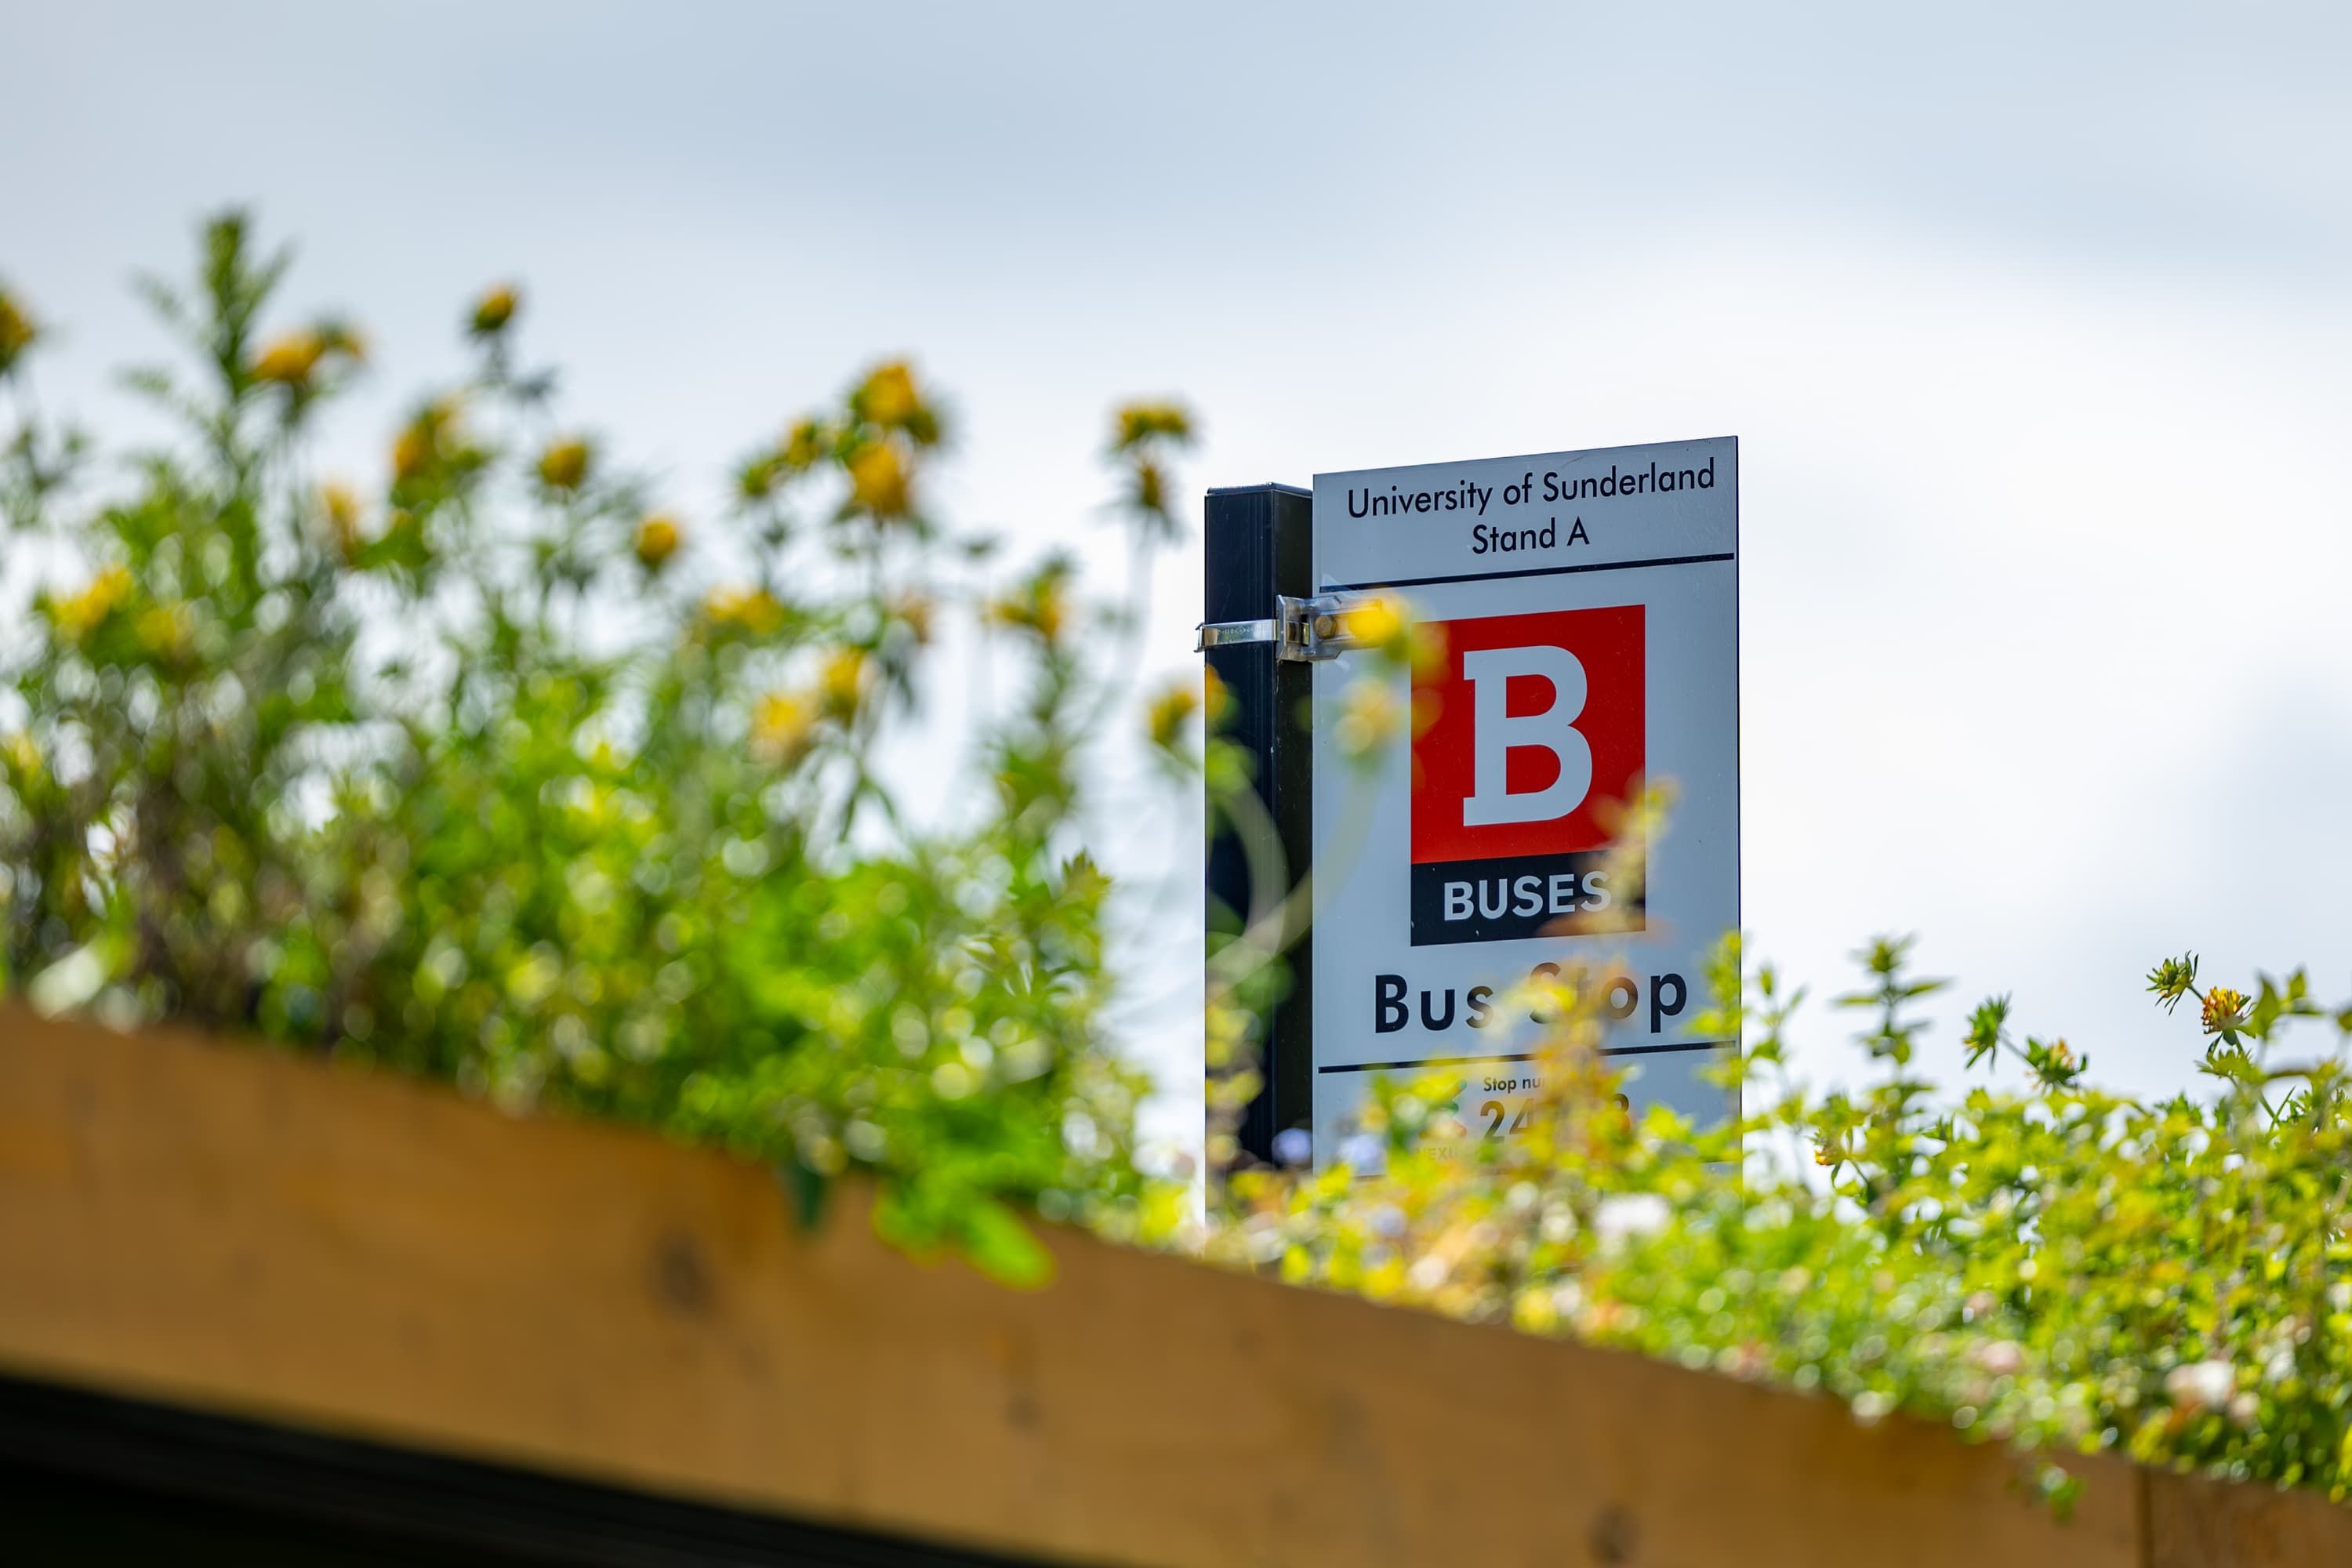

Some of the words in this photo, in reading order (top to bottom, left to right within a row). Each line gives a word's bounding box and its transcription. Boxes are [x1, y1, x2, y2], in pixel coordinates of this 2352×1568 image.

[1347, 479, 1494, 518] University
[1503, 472, 1534, 505] of
[1542, 456, 1715, 502] Sunderland
[1472, 517, 1556, 554] Stand
[1566, 516, 1591, 546] A
[1463, 644, 1593, 827] B
[1443, 870, 1612, 921] BUSES
[1374, 974, 1494, 1034] Bus
[1483, 1076, 1517, 1094] Stop
